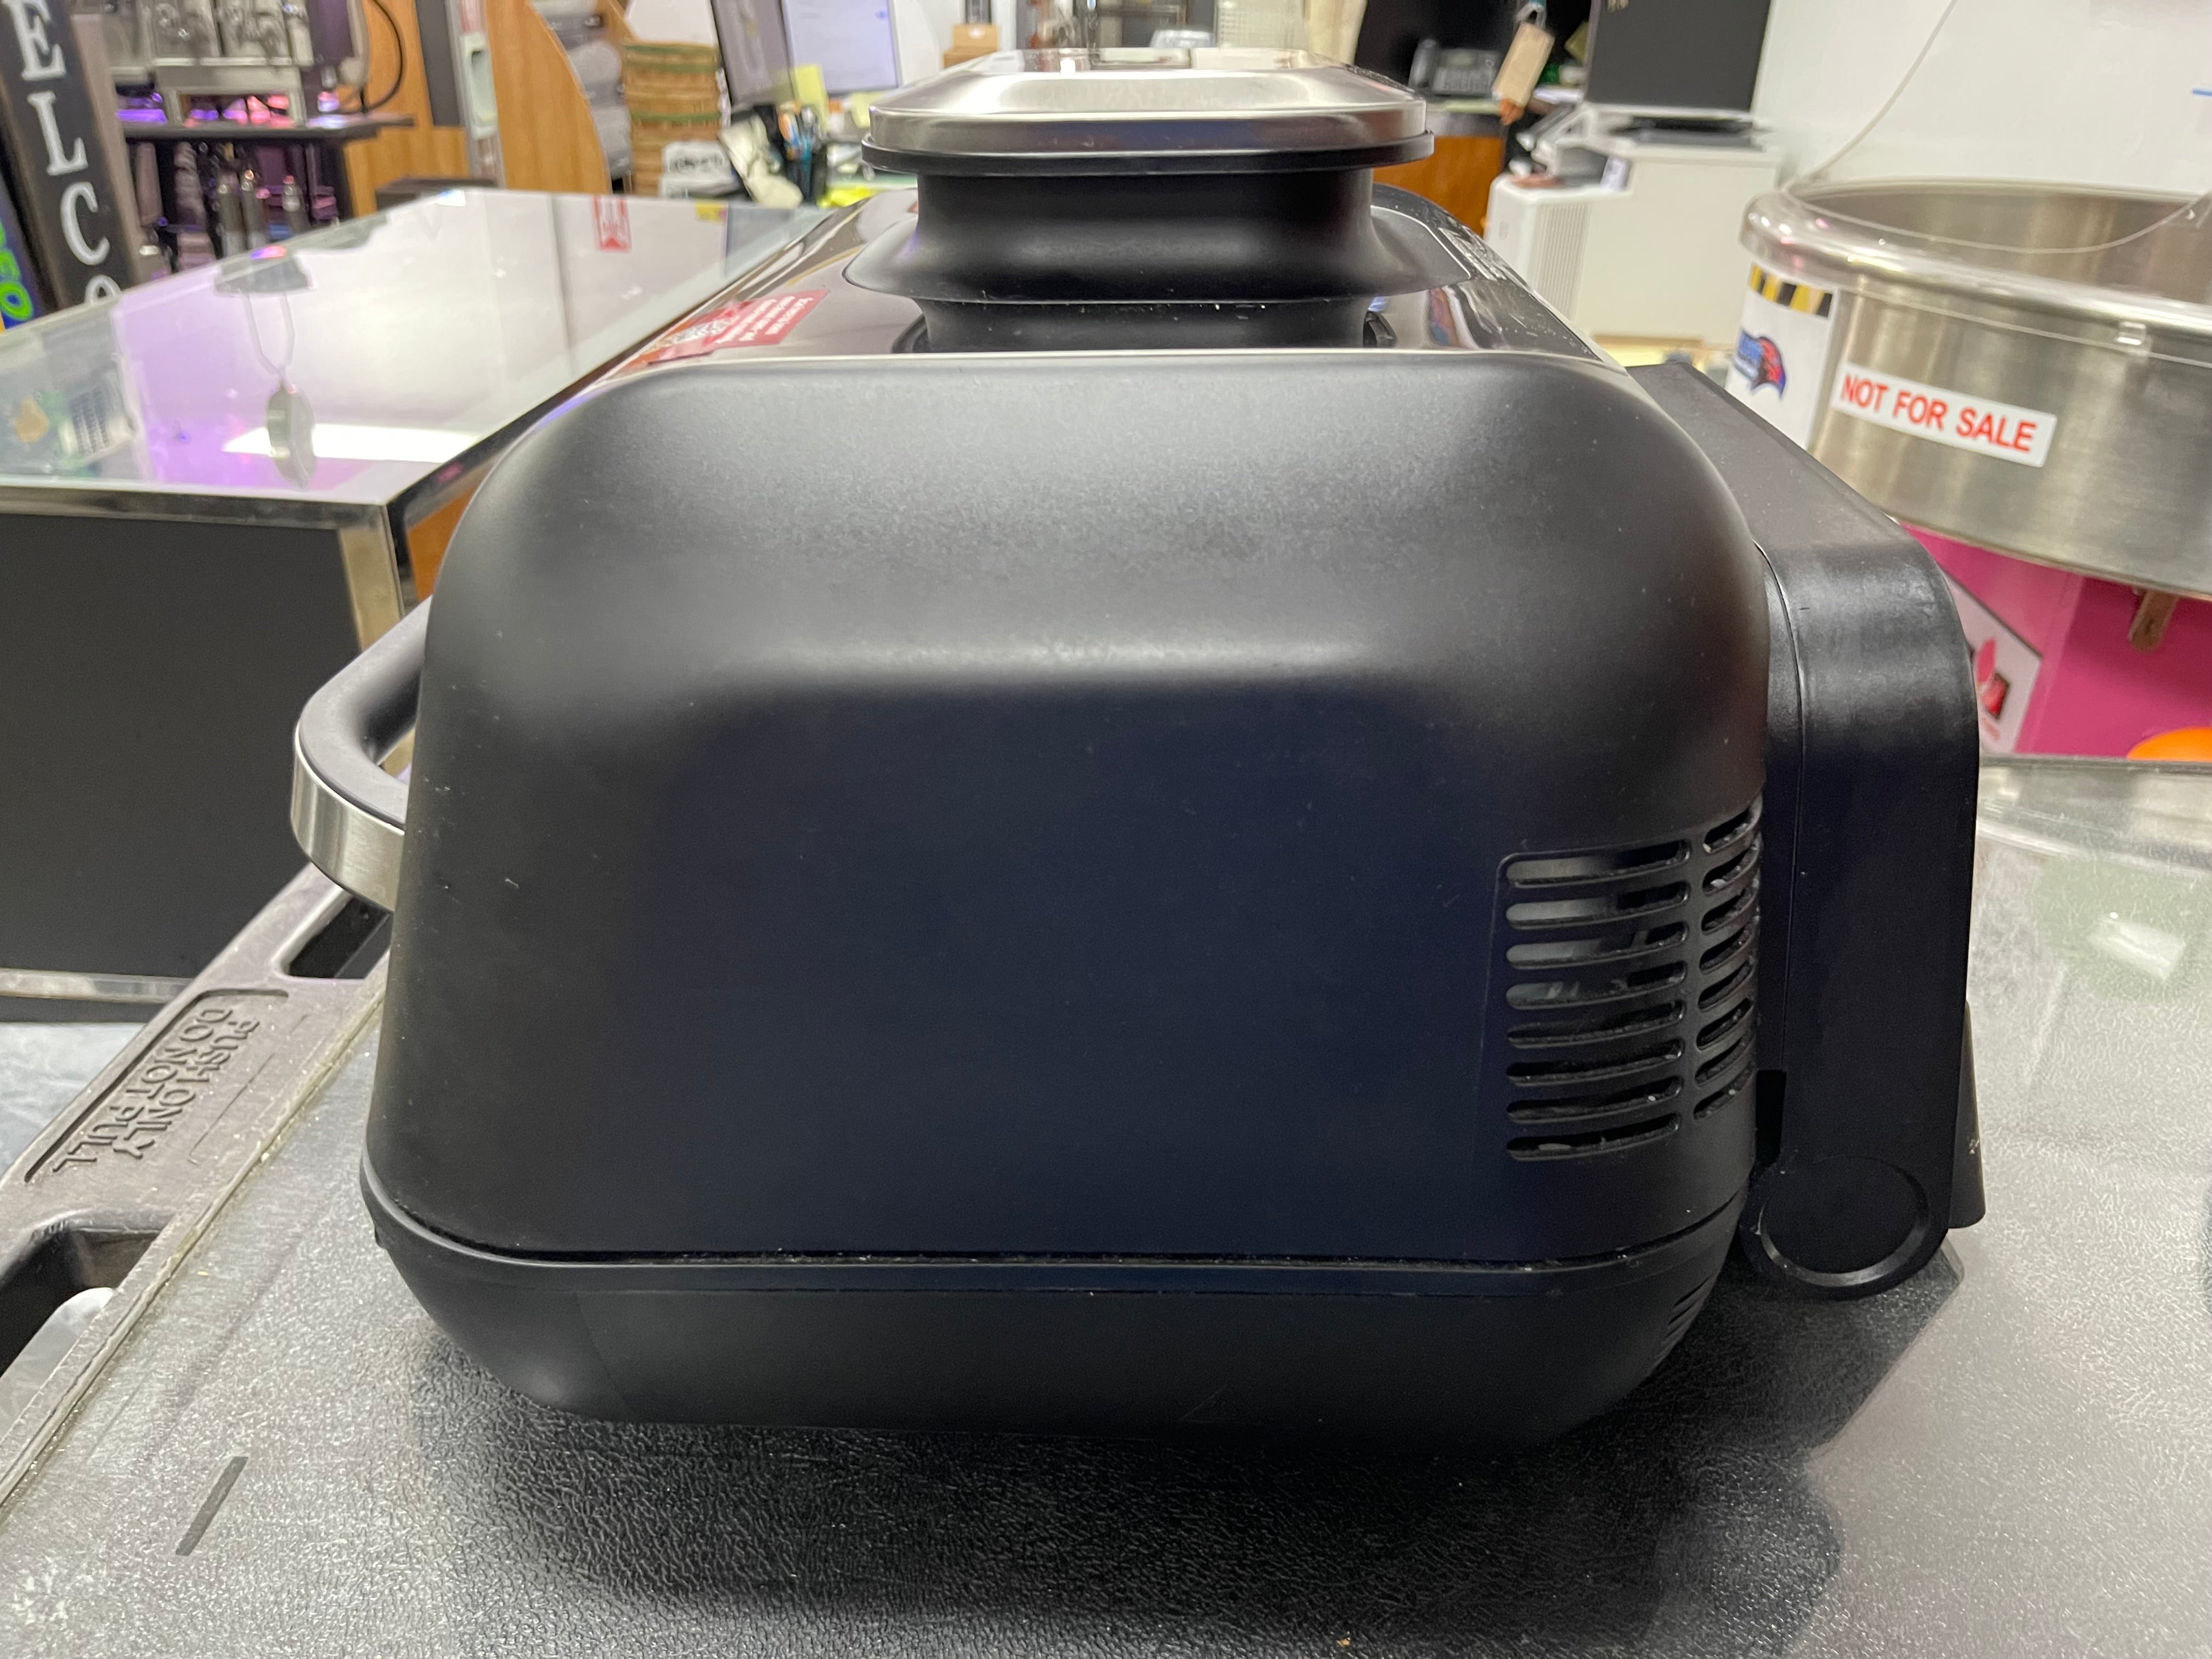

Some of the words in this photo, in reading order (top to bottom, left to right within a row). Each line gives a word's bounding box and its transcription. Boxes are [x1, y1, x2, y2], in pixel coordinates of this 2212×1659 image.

[1842, 375, 1888, 410] NOT
[1893, 391, 1947, 430] FOR
[1956, 408, 2036, 452] SALE
[176, 1020, 259, 1084] PUSH
[179, 1009, 234, 1042] DO
[125, 1048, 198, 1099] NOT
[52, 1105, 145, 1173] PULL
[112, 1088, 196, 1160] ONLY
